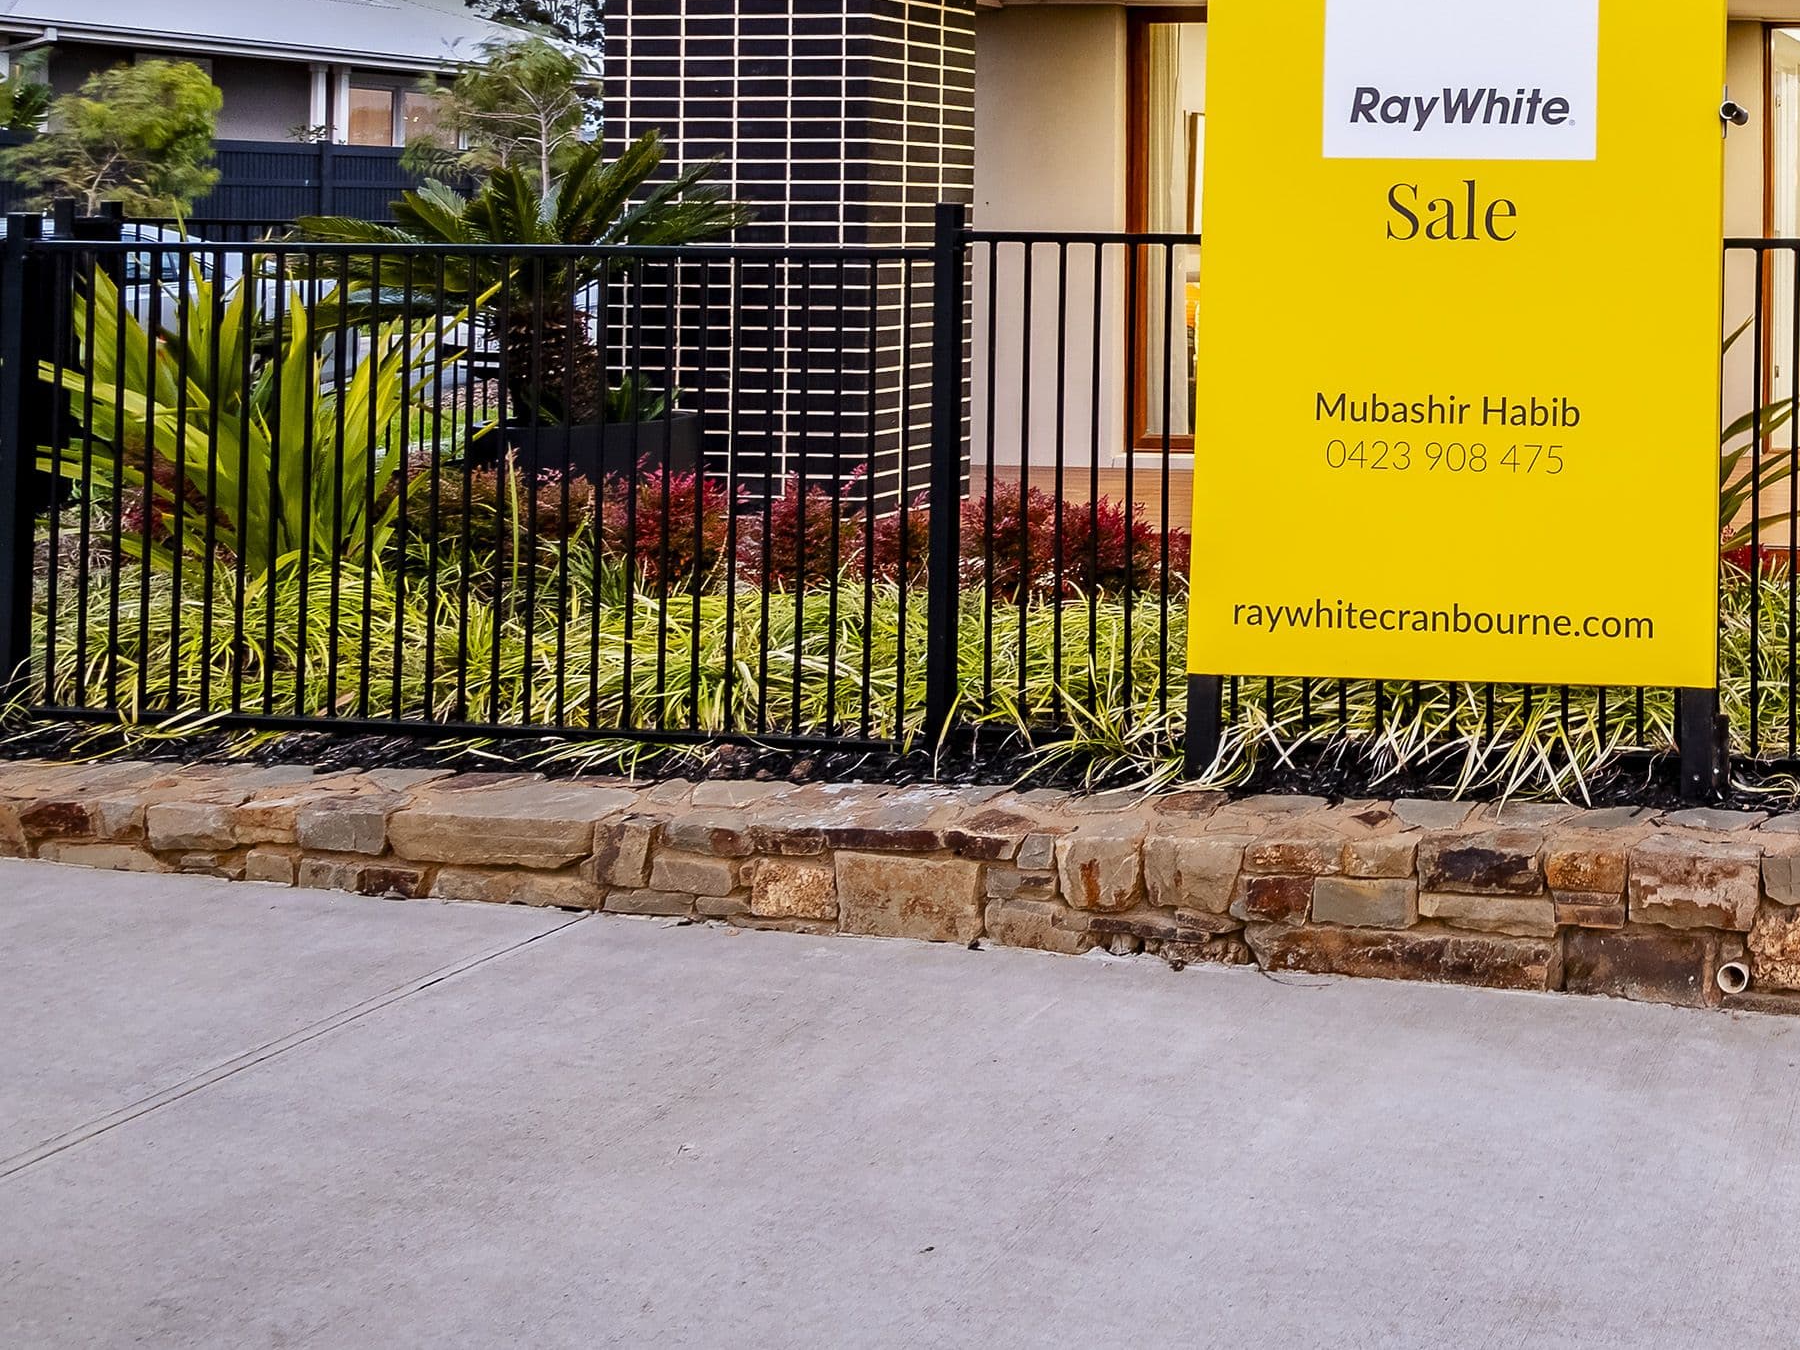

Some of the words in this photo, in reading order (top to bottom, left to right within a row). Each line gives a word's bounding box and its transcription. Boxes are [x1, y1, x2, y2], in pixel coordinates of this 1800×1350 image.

[1350, 87, 1570, 131] RayWhite
[1387, 180, 1517, 241] Sale
[1315, 392, 1471, 424] Mubashir
[1482, 396, 1581, 427] Habib
[1326, 439, 1411, 470] 0423
[1425, 442, 1487, 472] 908
[1500, 444, 1564, 474] 475
[1233, 598, 1654, 639] raywhitecranbourne.com
